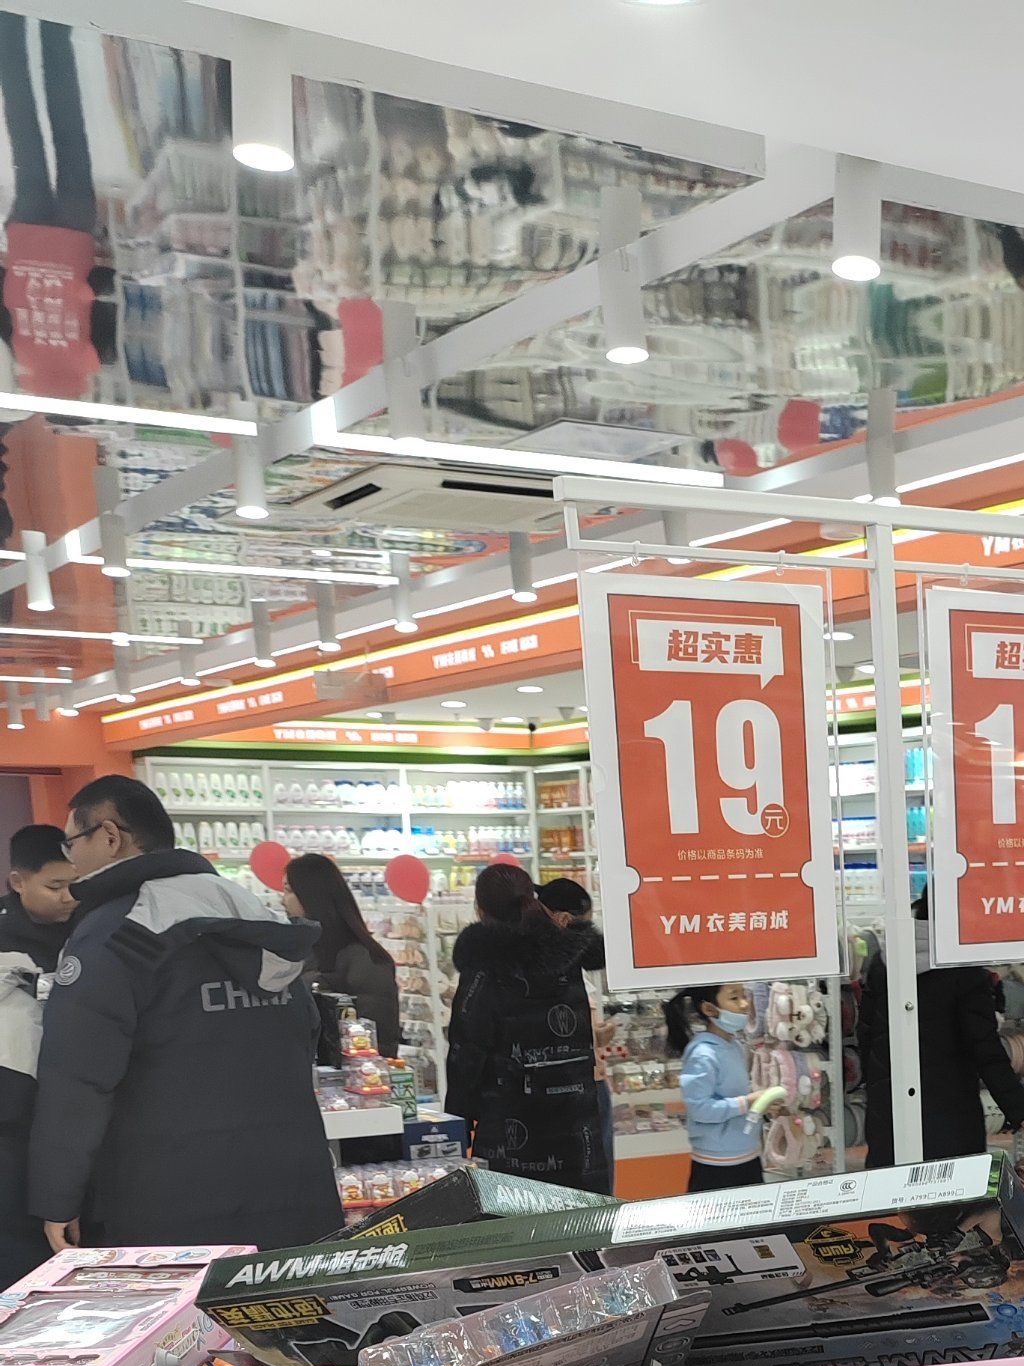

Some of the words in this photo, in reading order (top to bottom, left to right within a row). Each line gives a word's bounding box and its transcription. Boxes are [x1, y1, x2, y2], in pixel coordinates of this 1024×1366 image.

[667, 629, 764, 665] 超实惠
[643, 699, 784, 836] 19
[659, 910, 789, 935] YM衣美商城
